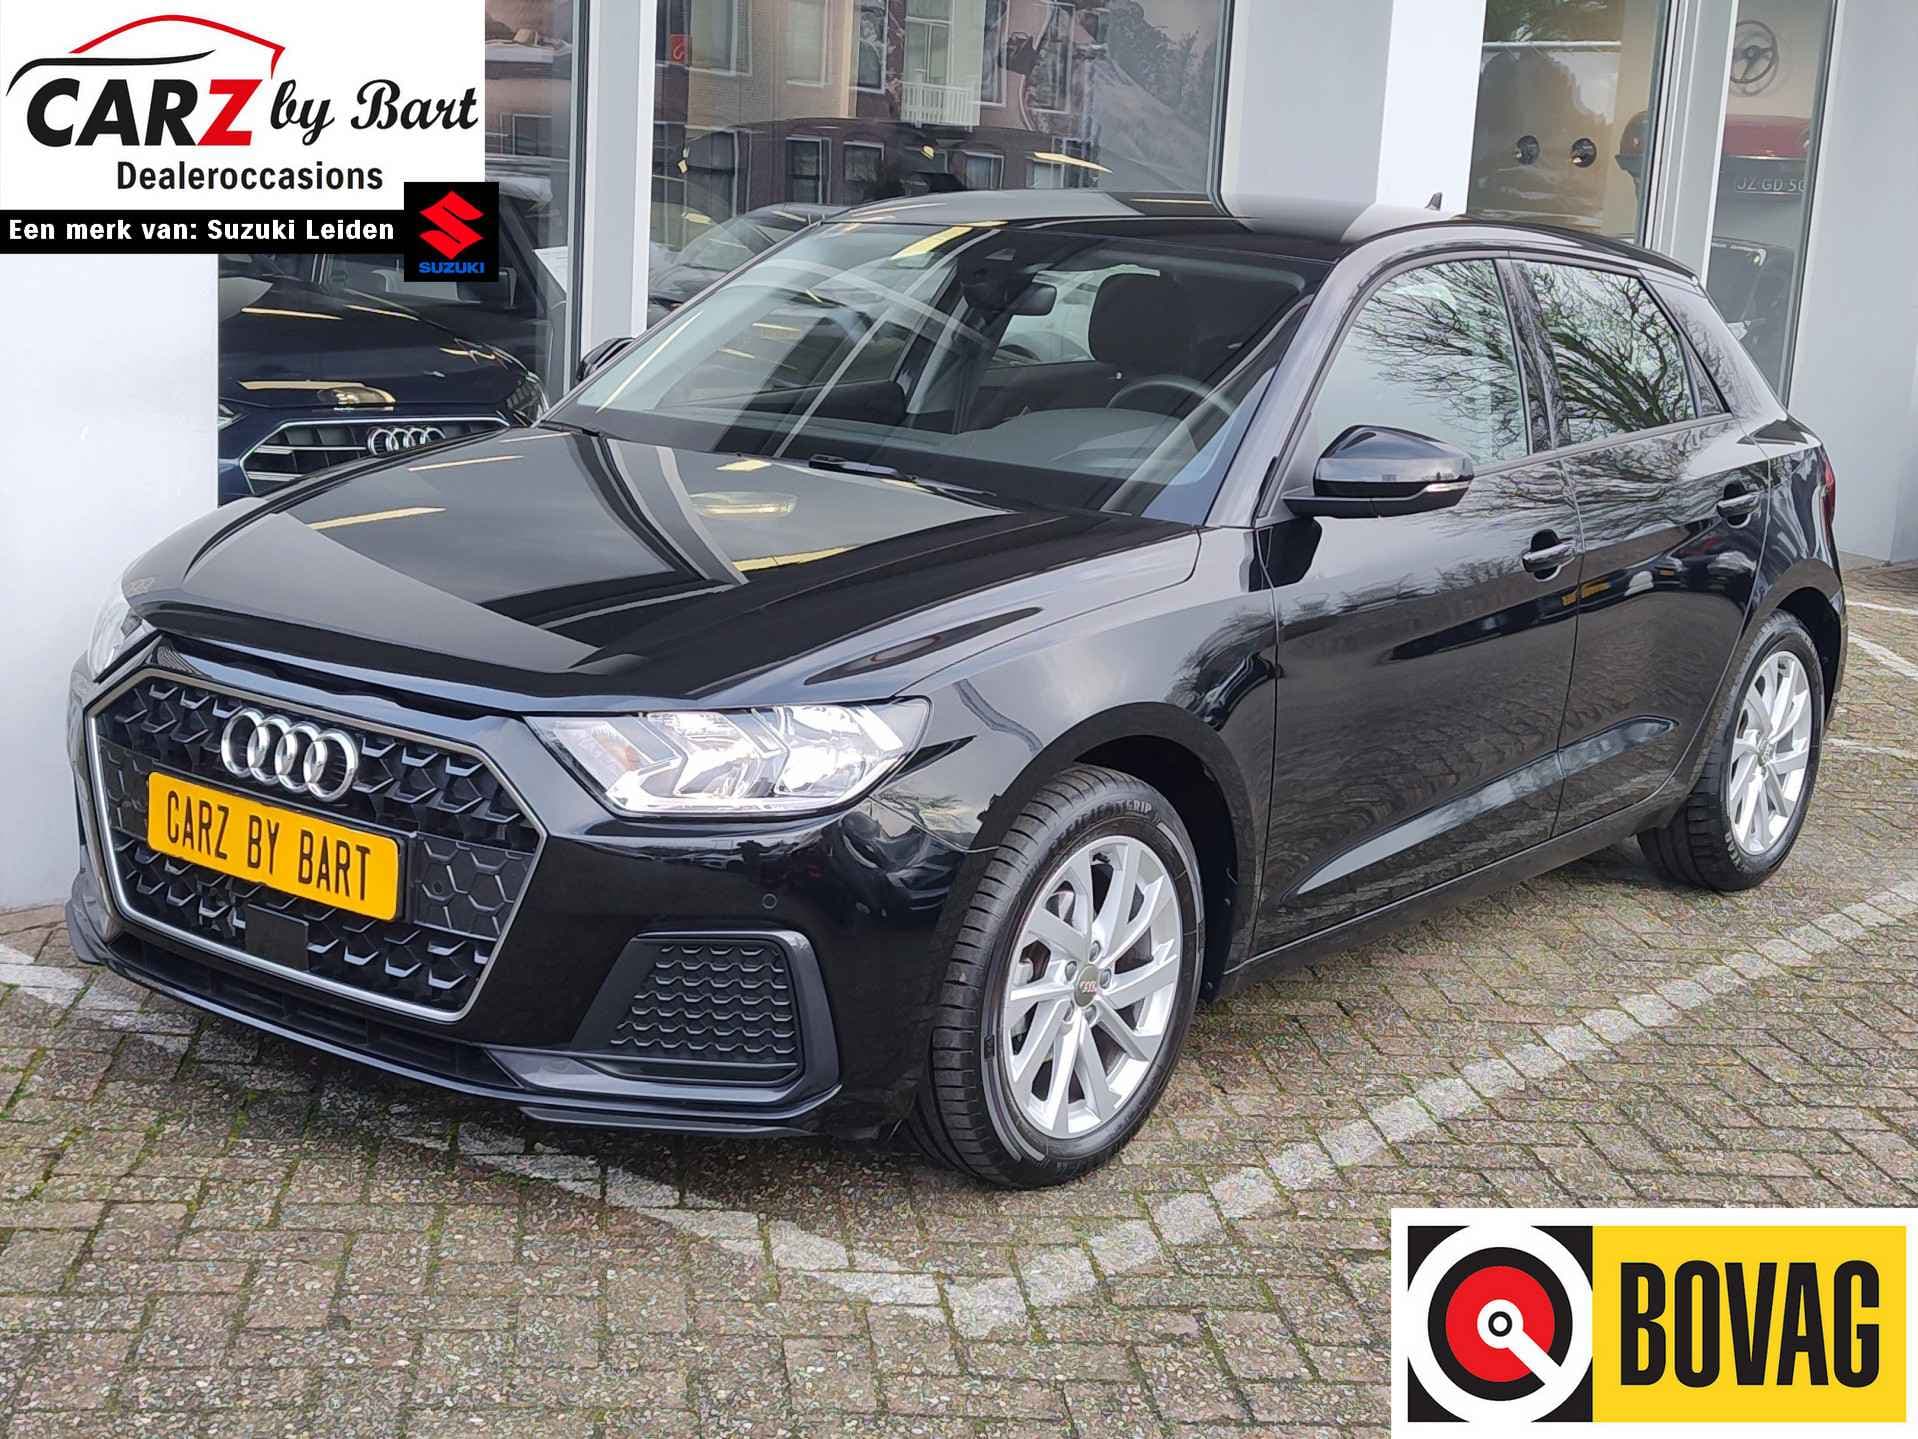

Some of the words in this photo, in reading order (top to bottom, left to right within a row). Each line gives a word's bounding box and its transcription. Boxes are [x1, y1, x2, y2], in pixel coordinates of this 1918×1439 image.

[167, 790, 230, 860] CARZ
[247, 814, 280, 876] BY
[298, 829, 372, 901] BART
